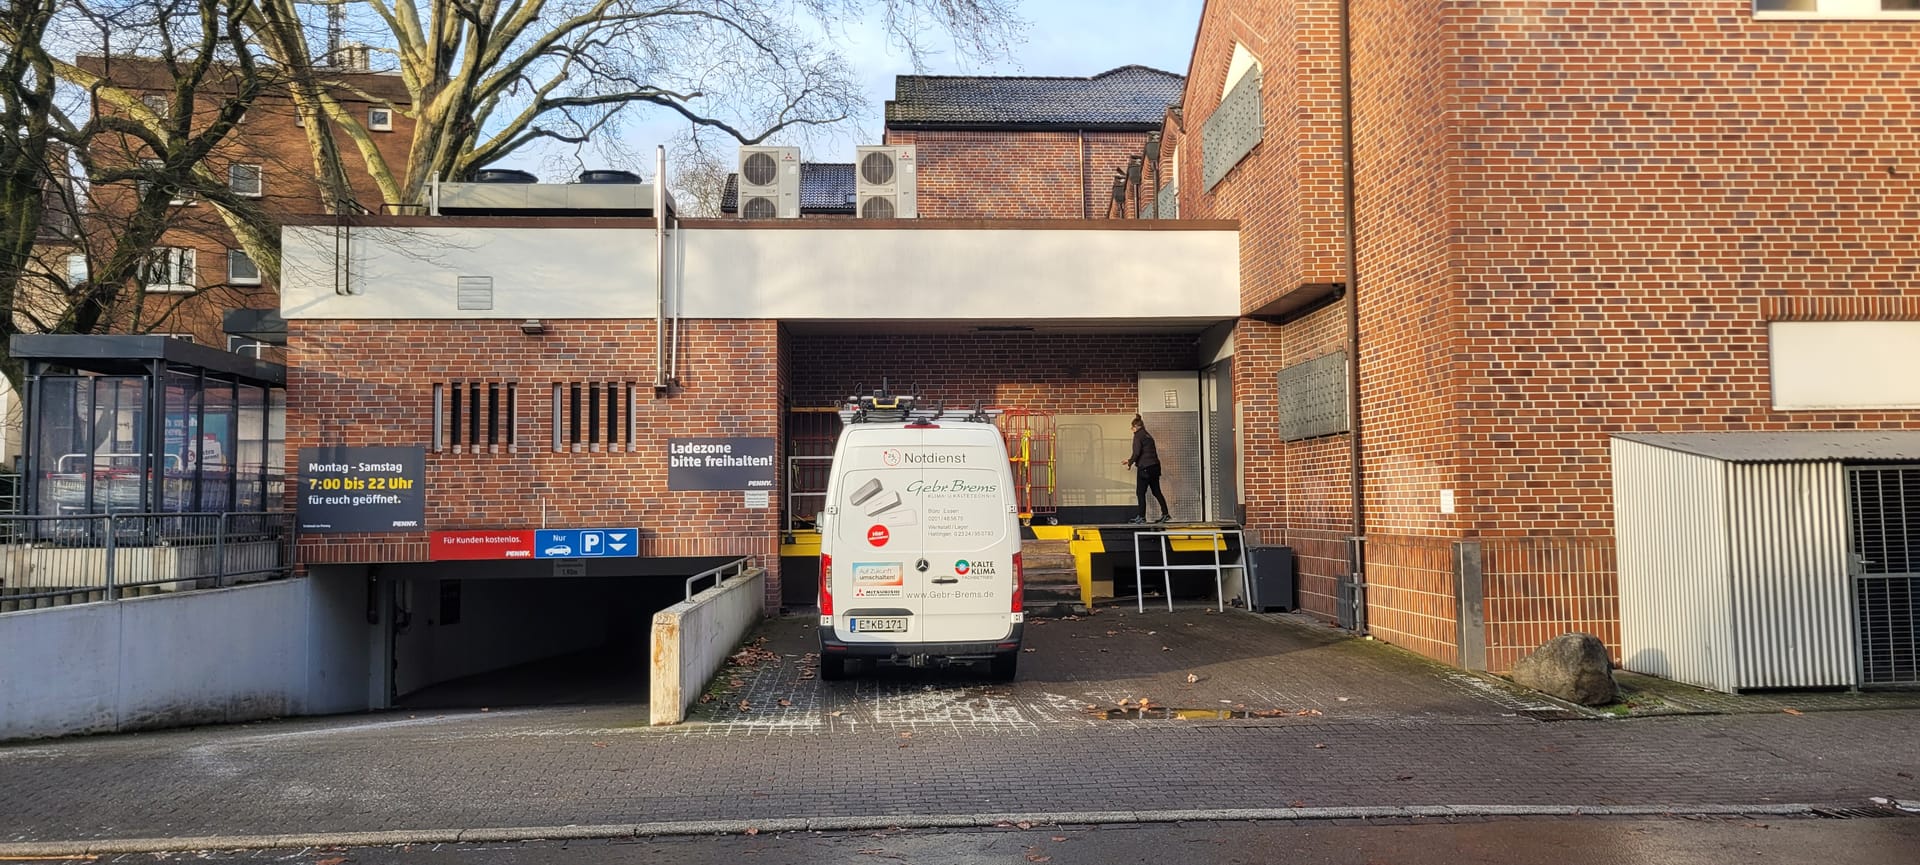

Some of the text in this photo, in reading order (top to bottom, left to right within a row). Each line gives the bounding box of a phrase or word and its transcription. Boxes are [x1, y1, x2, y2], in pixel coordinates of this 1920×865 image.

[671, 442, 732, 454] Ladezone
[671, 455, 773, 467] bitte freihalten!
[904, 452, 966, 464] Notdienst
[309, 462, 349, 474] Montag
[358, 462, 403, 474] Samstag
[309, 477, 414, 490] 7:00 bis 22 Uhr
[950, 479, 997, 493] Brems
[308, 494, 402, 506] für euch geöffnet.
[443, 535, 522, 544] Für Kunden kostenlos.
[552, 534, 566, 542] Nur
[584, 534, 599, 552] P
[906, 590, 994, 599] www.Gebr-Brems.de
[859, 620, 903, 630] E KB 171
